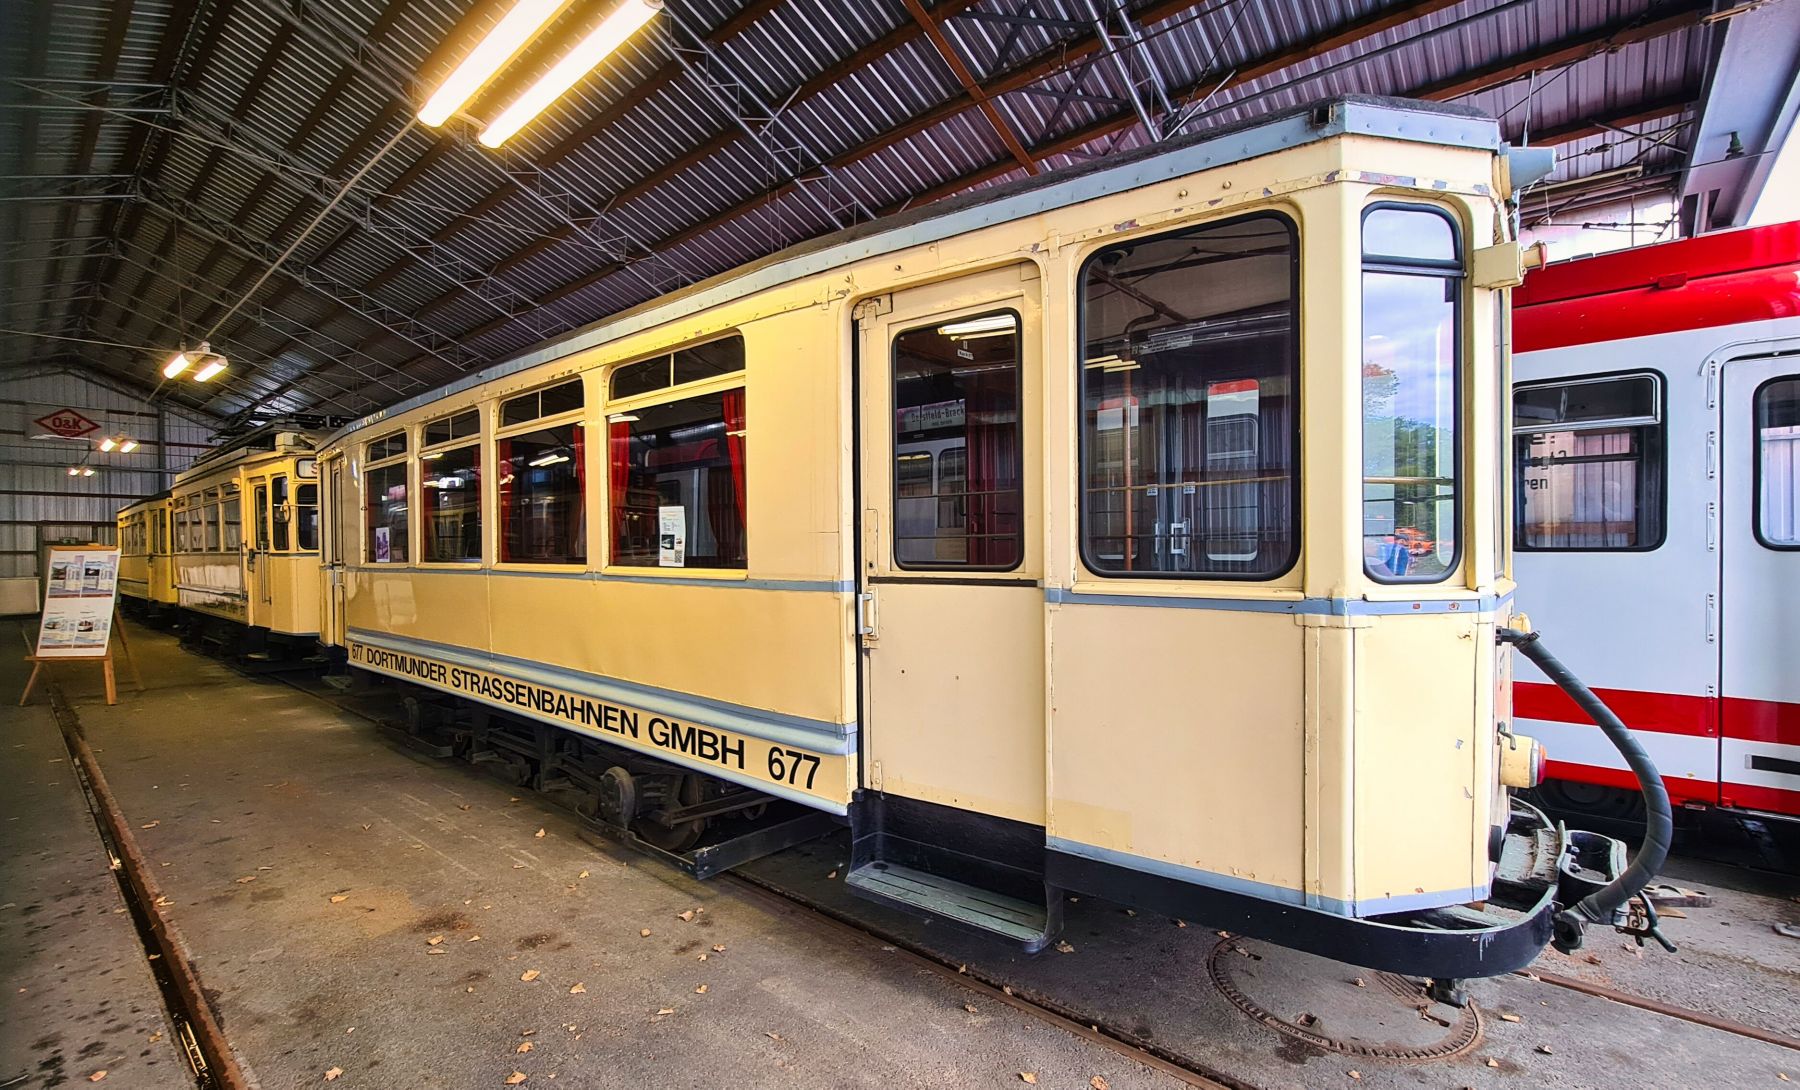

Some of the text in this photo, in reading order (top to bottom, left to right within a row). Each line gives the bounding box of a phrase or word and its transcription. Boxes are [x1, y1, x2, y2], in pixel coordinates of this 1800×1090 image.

[52, 417, 82, 430] O&K
[351, 643, 821, 790] 677 DORTMUNDER STRASSENBAHNEN GMBH 677
